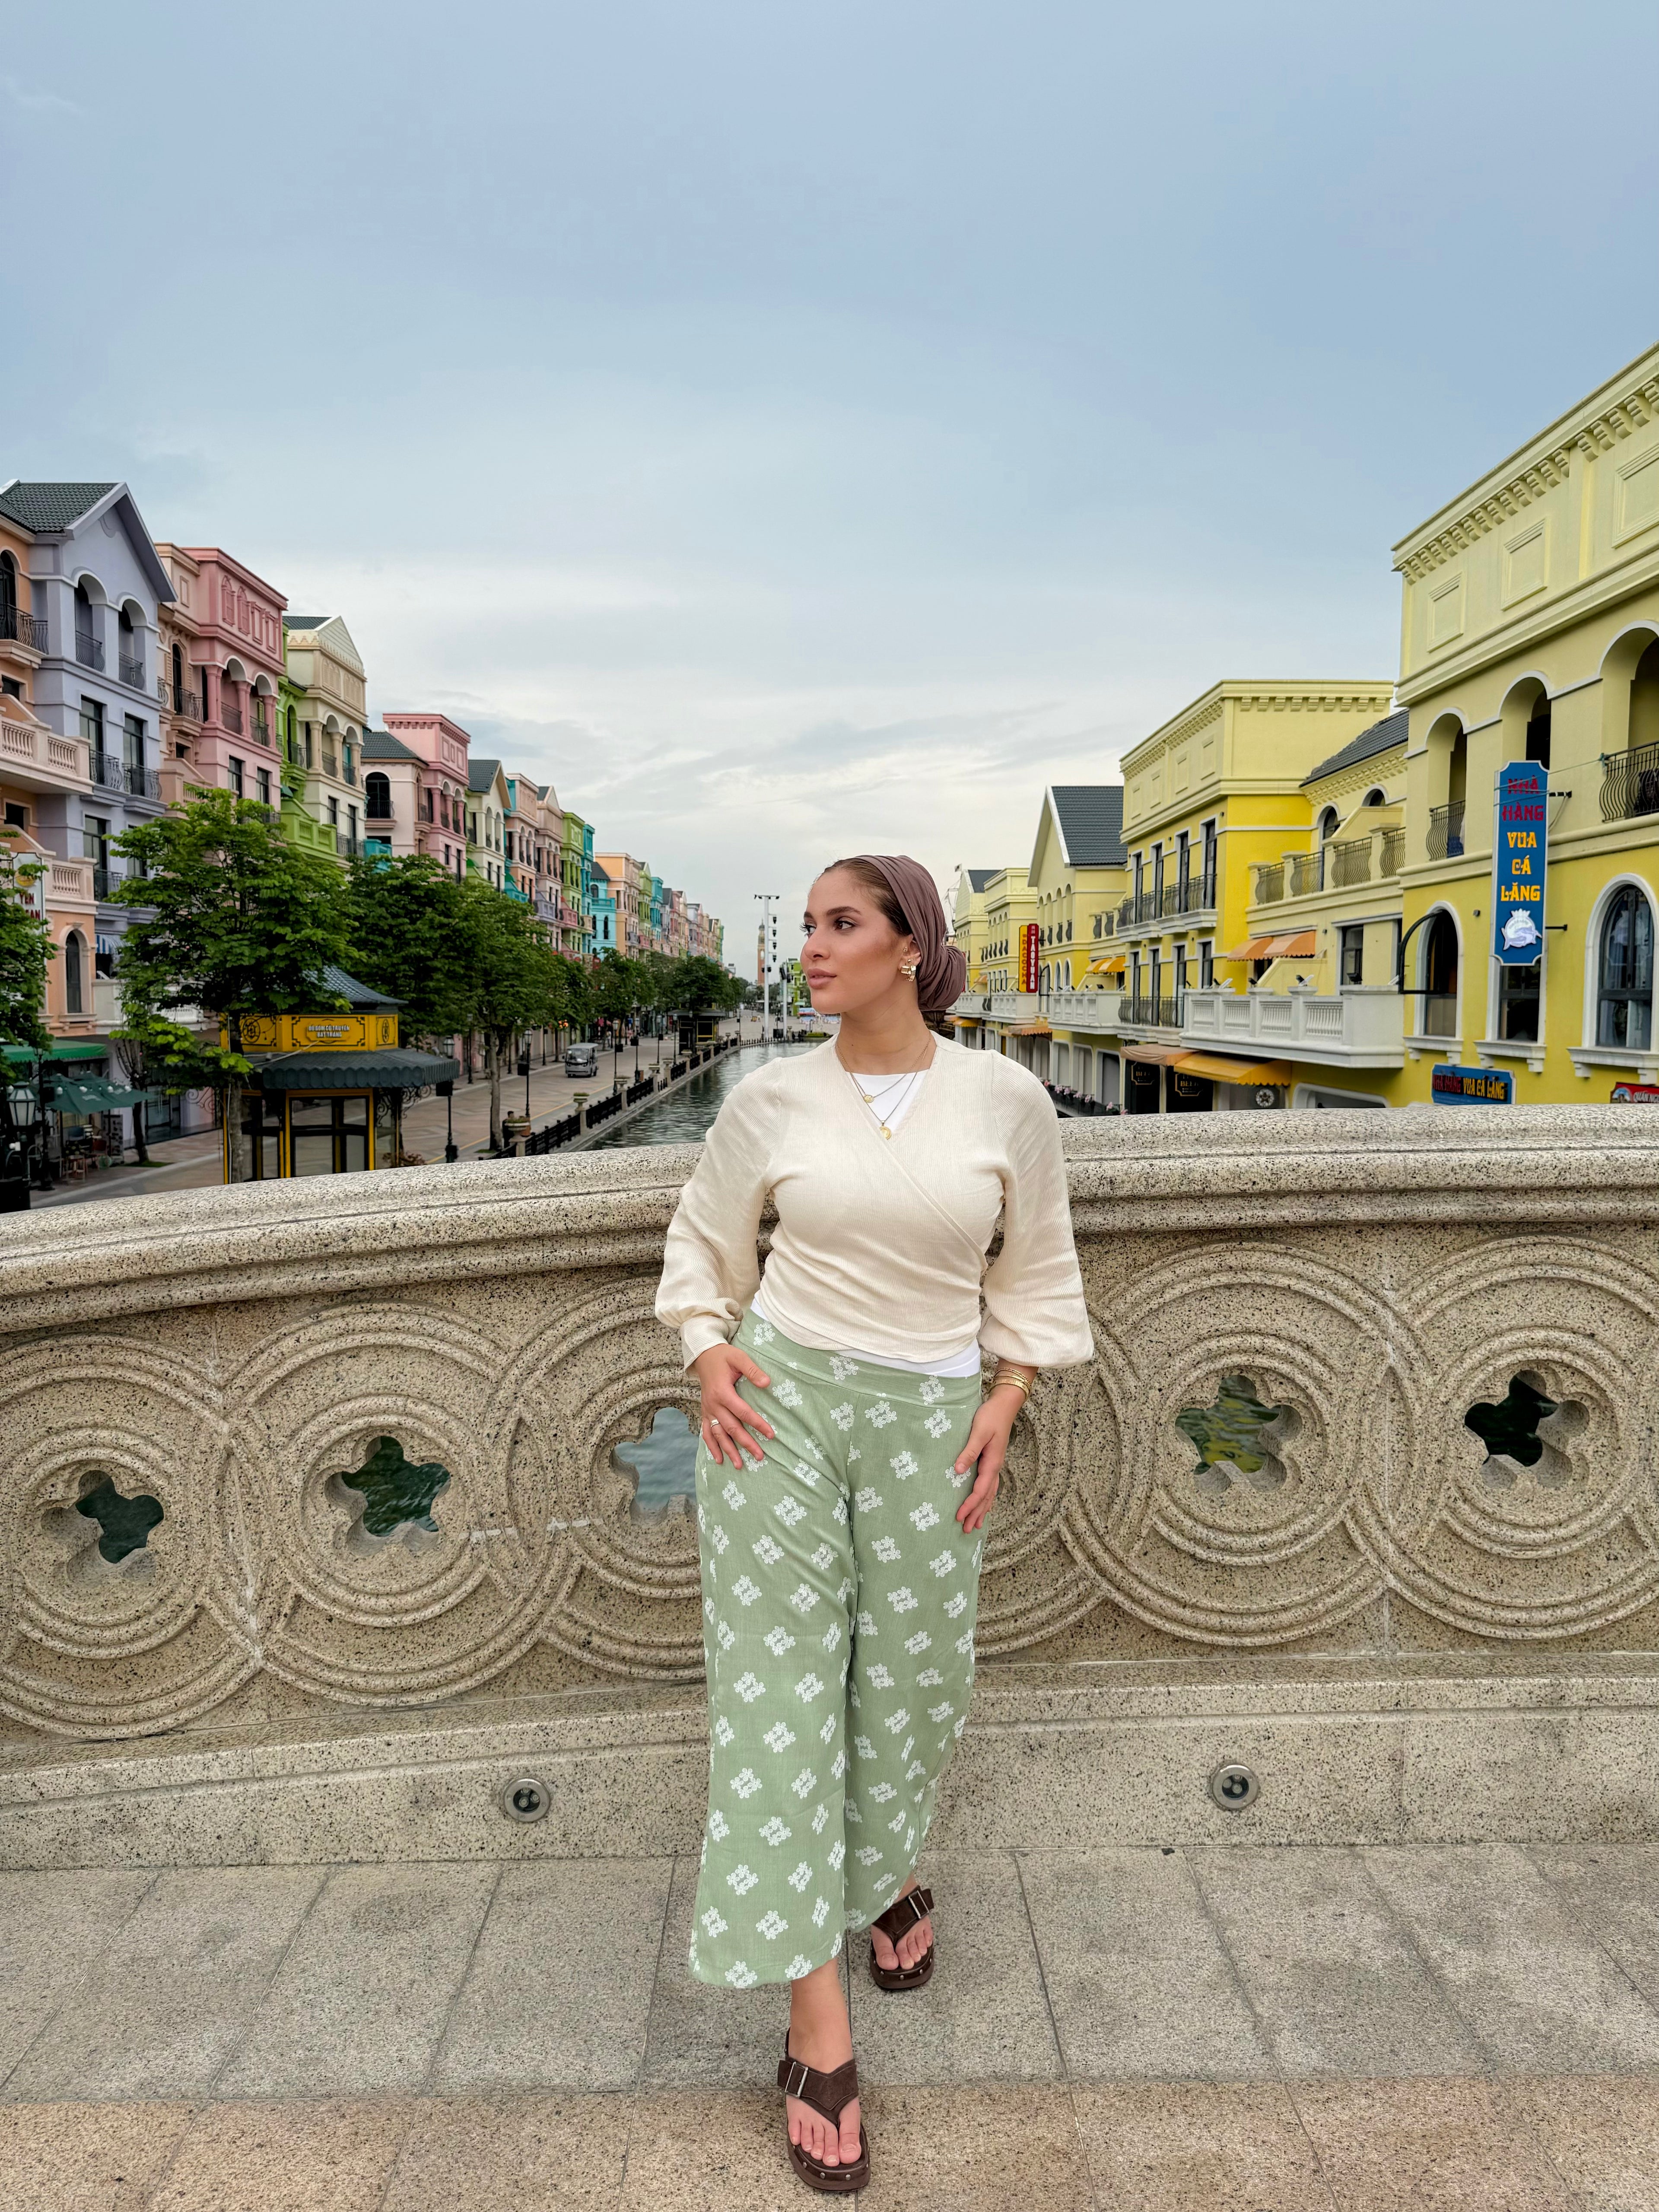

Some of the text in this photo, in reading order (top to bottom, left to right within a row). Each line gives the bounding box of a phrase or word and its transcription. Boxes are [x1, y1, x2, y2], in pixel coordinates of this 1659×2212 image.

[1508, 775, 1540, 794] NHÀ
[1502, 802, 1544, 821] HÀNG
[1507, 832, 1537, 848] VUA
[1512, 855, 1531, 874] CÁ
[1501, 882, 1540, 901] LĂNG
[1463, 1077, 1475, 1095] VUA
